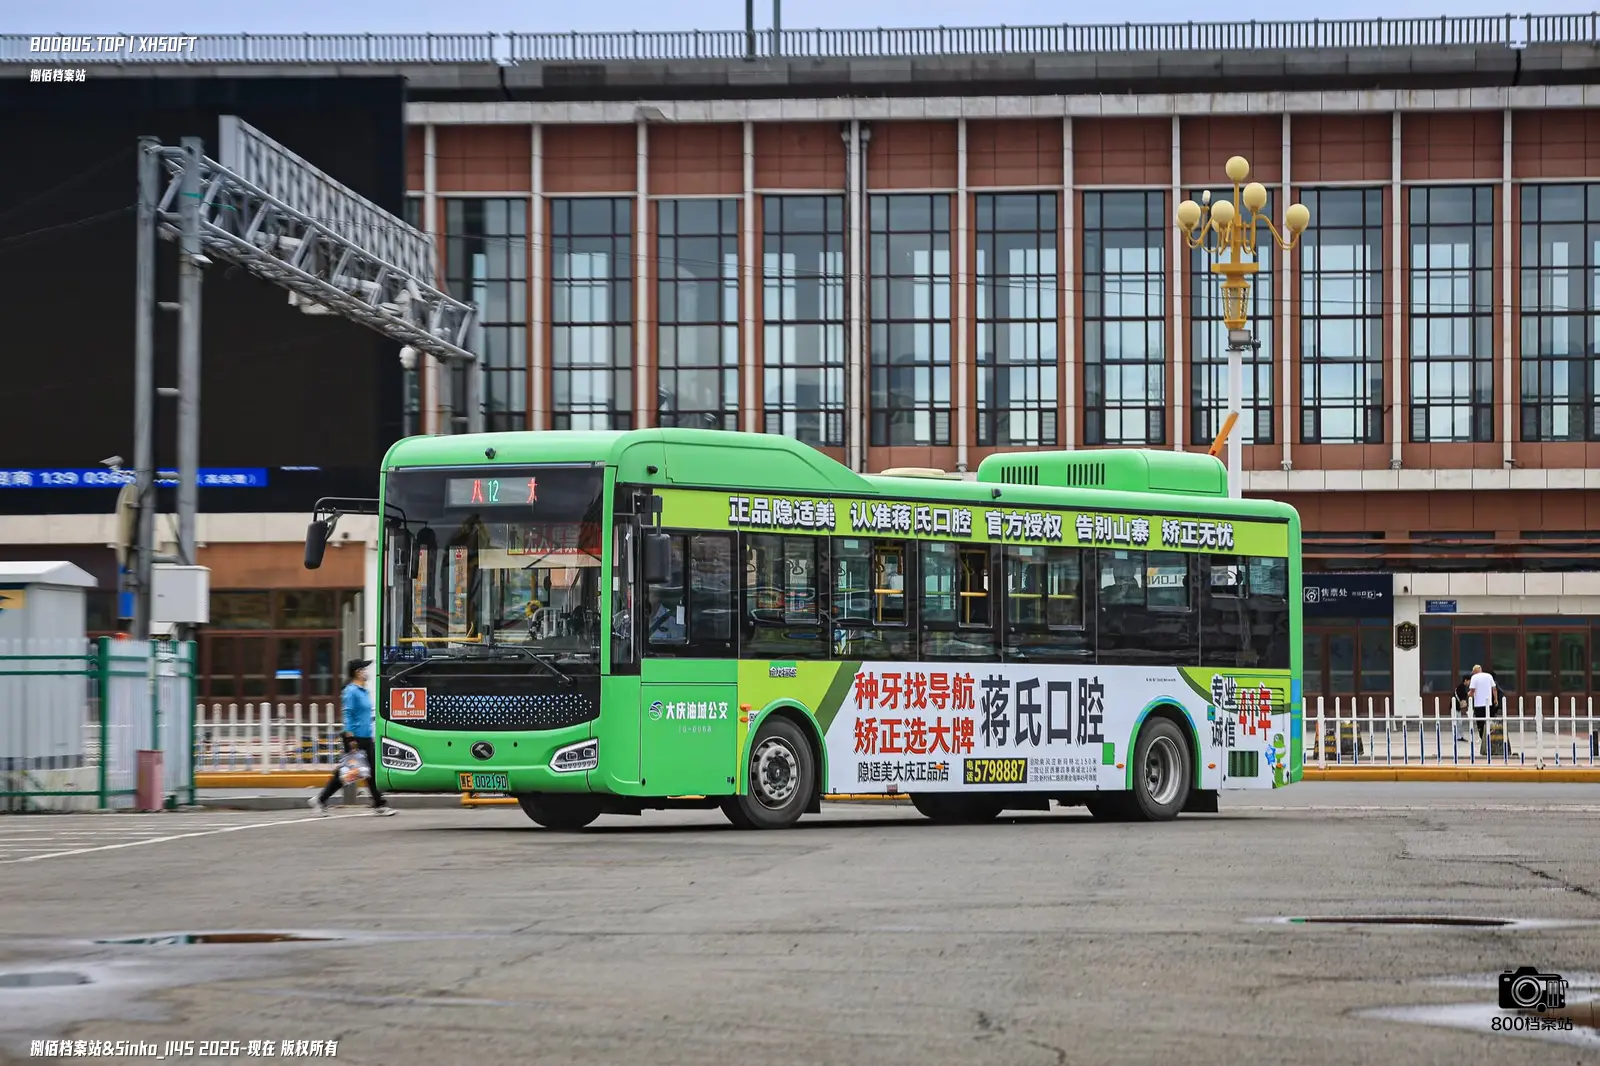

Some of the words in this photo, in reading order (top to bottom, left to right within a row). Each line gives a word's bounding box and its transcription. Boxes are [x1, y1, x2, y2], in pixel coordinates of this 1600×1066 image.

[487, 479, 499, 502] 12
[728, 496, 836, 531] 正品隐适美
[850, 502, 973, 535] 认准蒋氏口腔
[985, 510, 1062, 541] 官方授权
[1075, 514, 1150, 545] 告别山寨
[1161, 517, 1235, 549] 矫正无忧
[401, 690, 416, 709] 12
[853, 671, 976, 711] 种牙找导航
[665, 701, 729, 720] 大庆油城公交
[979, 674, 1105, 748] 蒋氏口腔
[853, 716, 975, 755] 矫正选大牌
[857, 760, 950, 783] 隐适美大庆正品店
[966, 760, 974, 783] 电话
[973, 759, 1027, 783] 5798887
